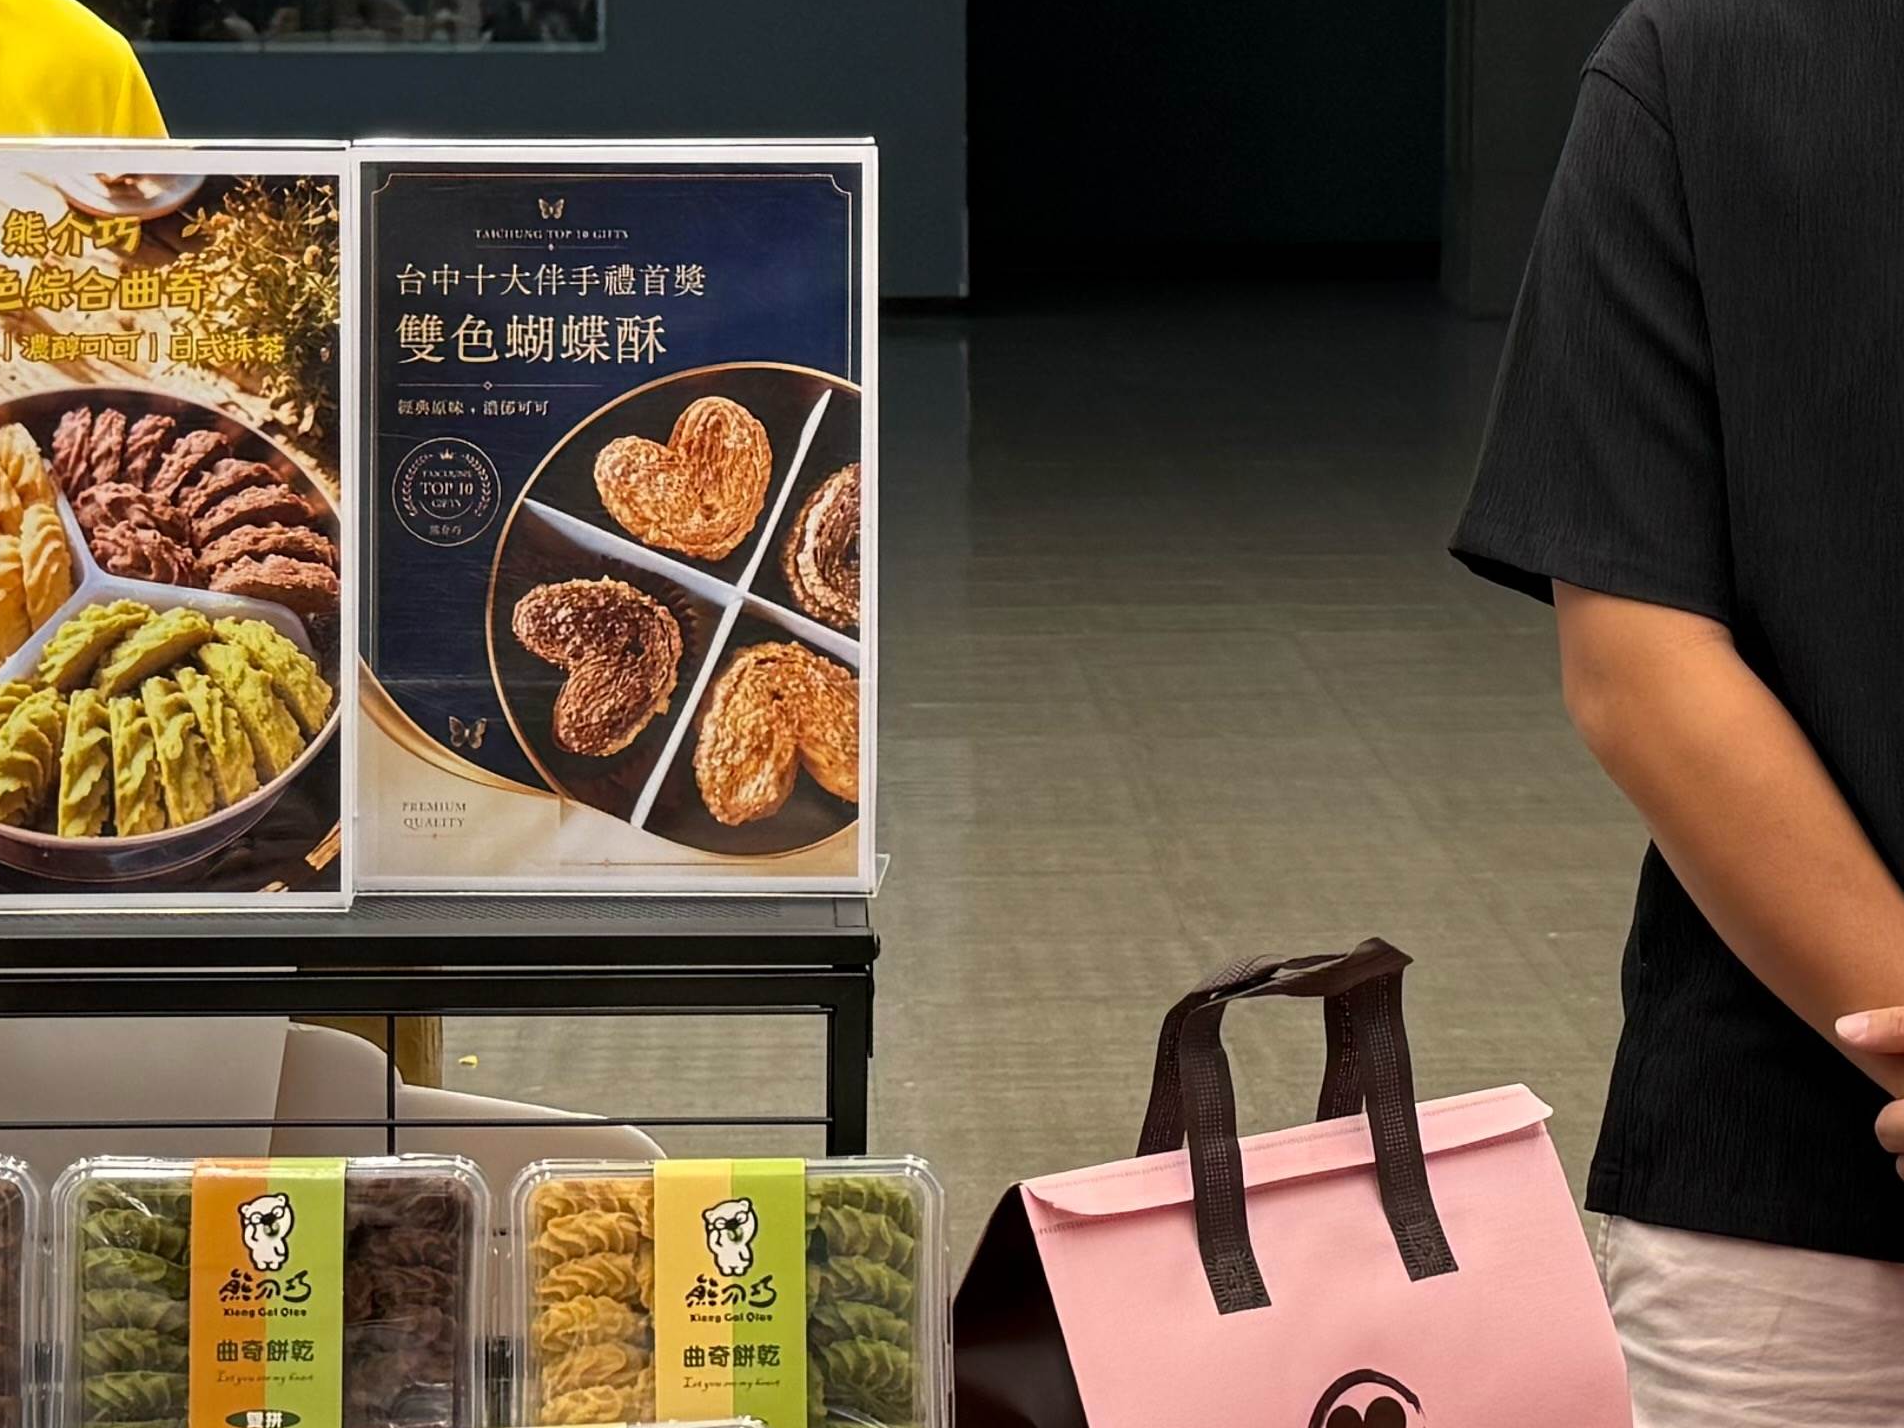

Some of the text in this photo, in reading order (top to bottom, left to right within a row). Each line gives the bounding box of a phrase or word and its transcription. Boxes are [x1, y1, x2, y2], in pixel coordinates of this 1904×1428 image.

[0, 209, 142, 257] 熊介巧
[474, 229, 630, 240] TAICHUNG TOP 10 GIFTS
[395, 262, 707, 297] 台中十大伴手禮首獎
[169, 333, 284, 362] 日式抹茶
[395, 312, 668, 365] 雙色蝴蝶酥
[420, 482, 474, 496] TOP 10
[402, 802, 467, 813] PREMIUM
[403, 817, 466, 829] QUALITY
[217, 1339, 315, 1362] 曲奇餅乾
[684, 1344, 781, 1367] 曲奇餅乾
